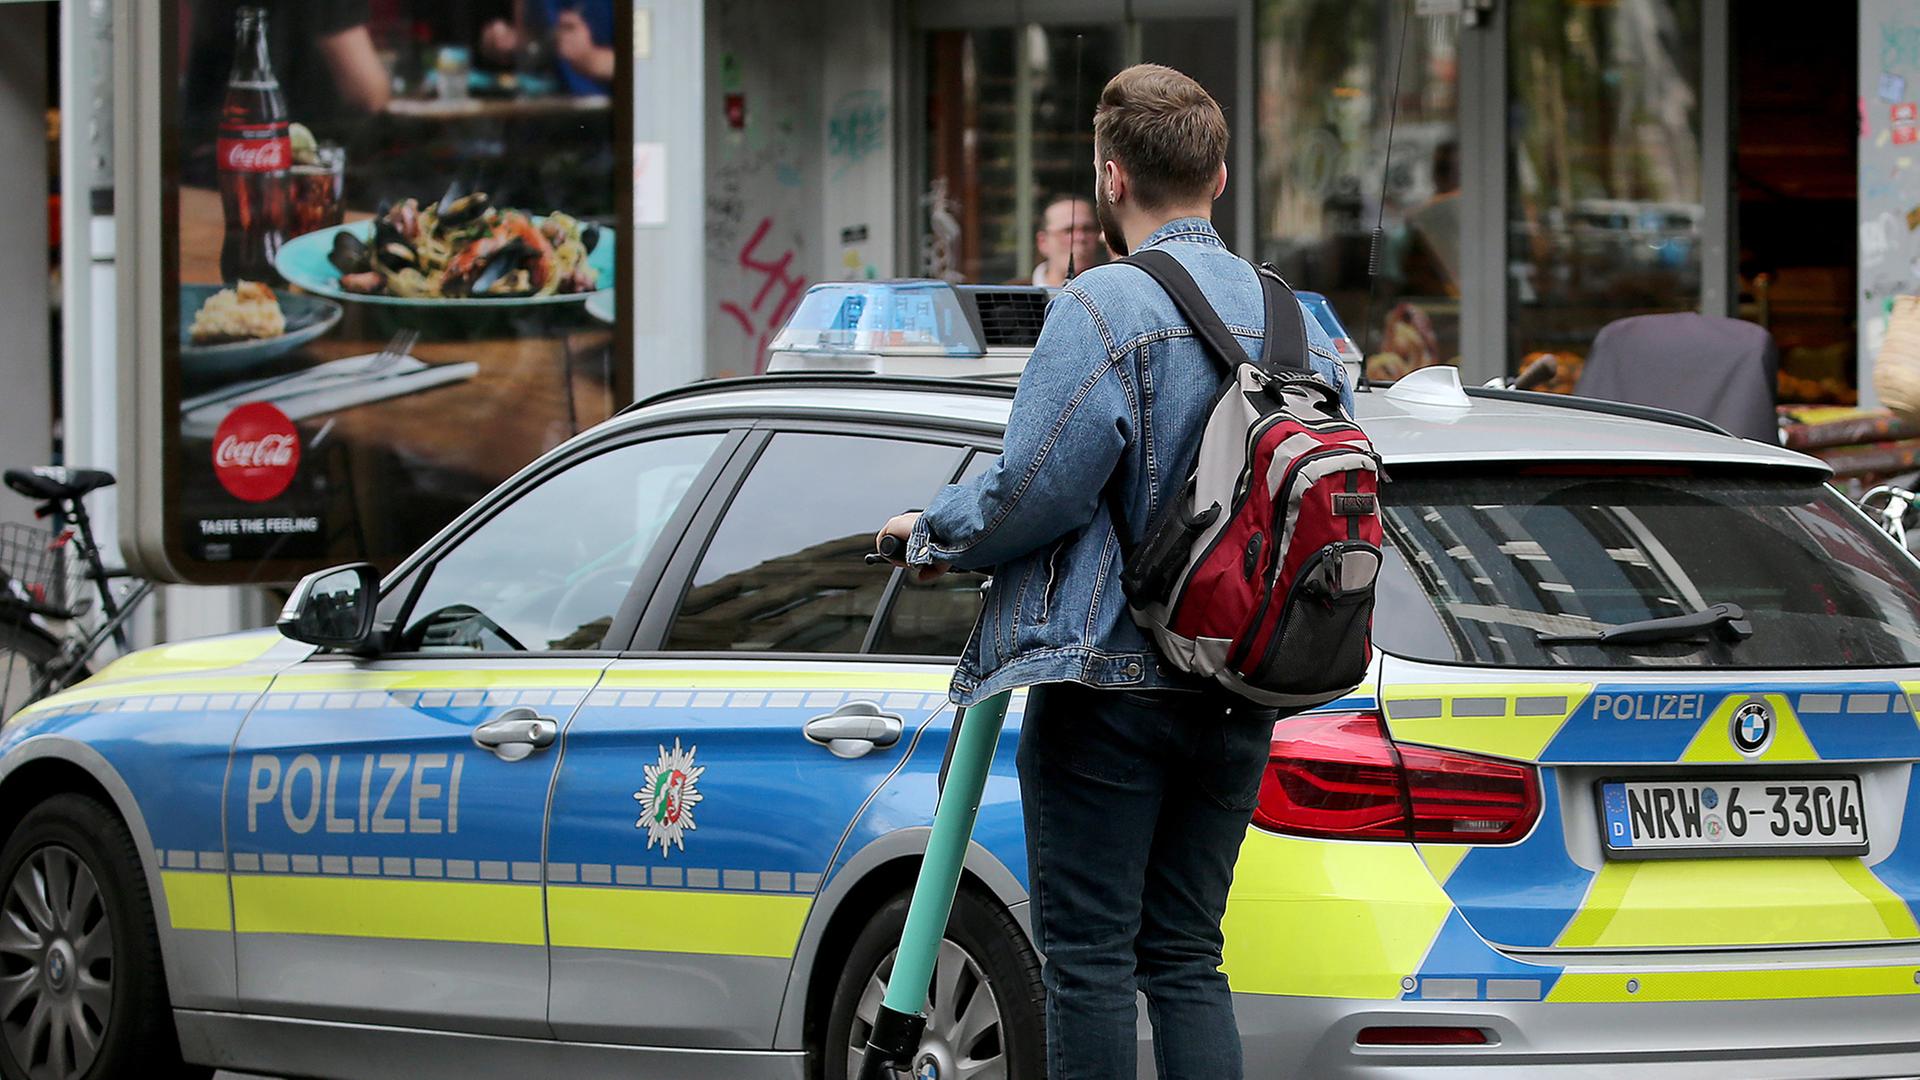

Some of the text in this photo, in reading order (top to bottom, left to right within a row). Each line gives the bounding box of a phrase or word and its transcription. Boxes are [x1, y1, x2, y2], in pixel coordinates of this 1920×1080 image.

[200, 517, 319, 534] TASTE THE FEELING
[1593, 694, 1704, 720] POLIZEI
[248, 753, 465, 834] POLIZEI
[1613, 786, 1859, 839] D NRW 6-3304
